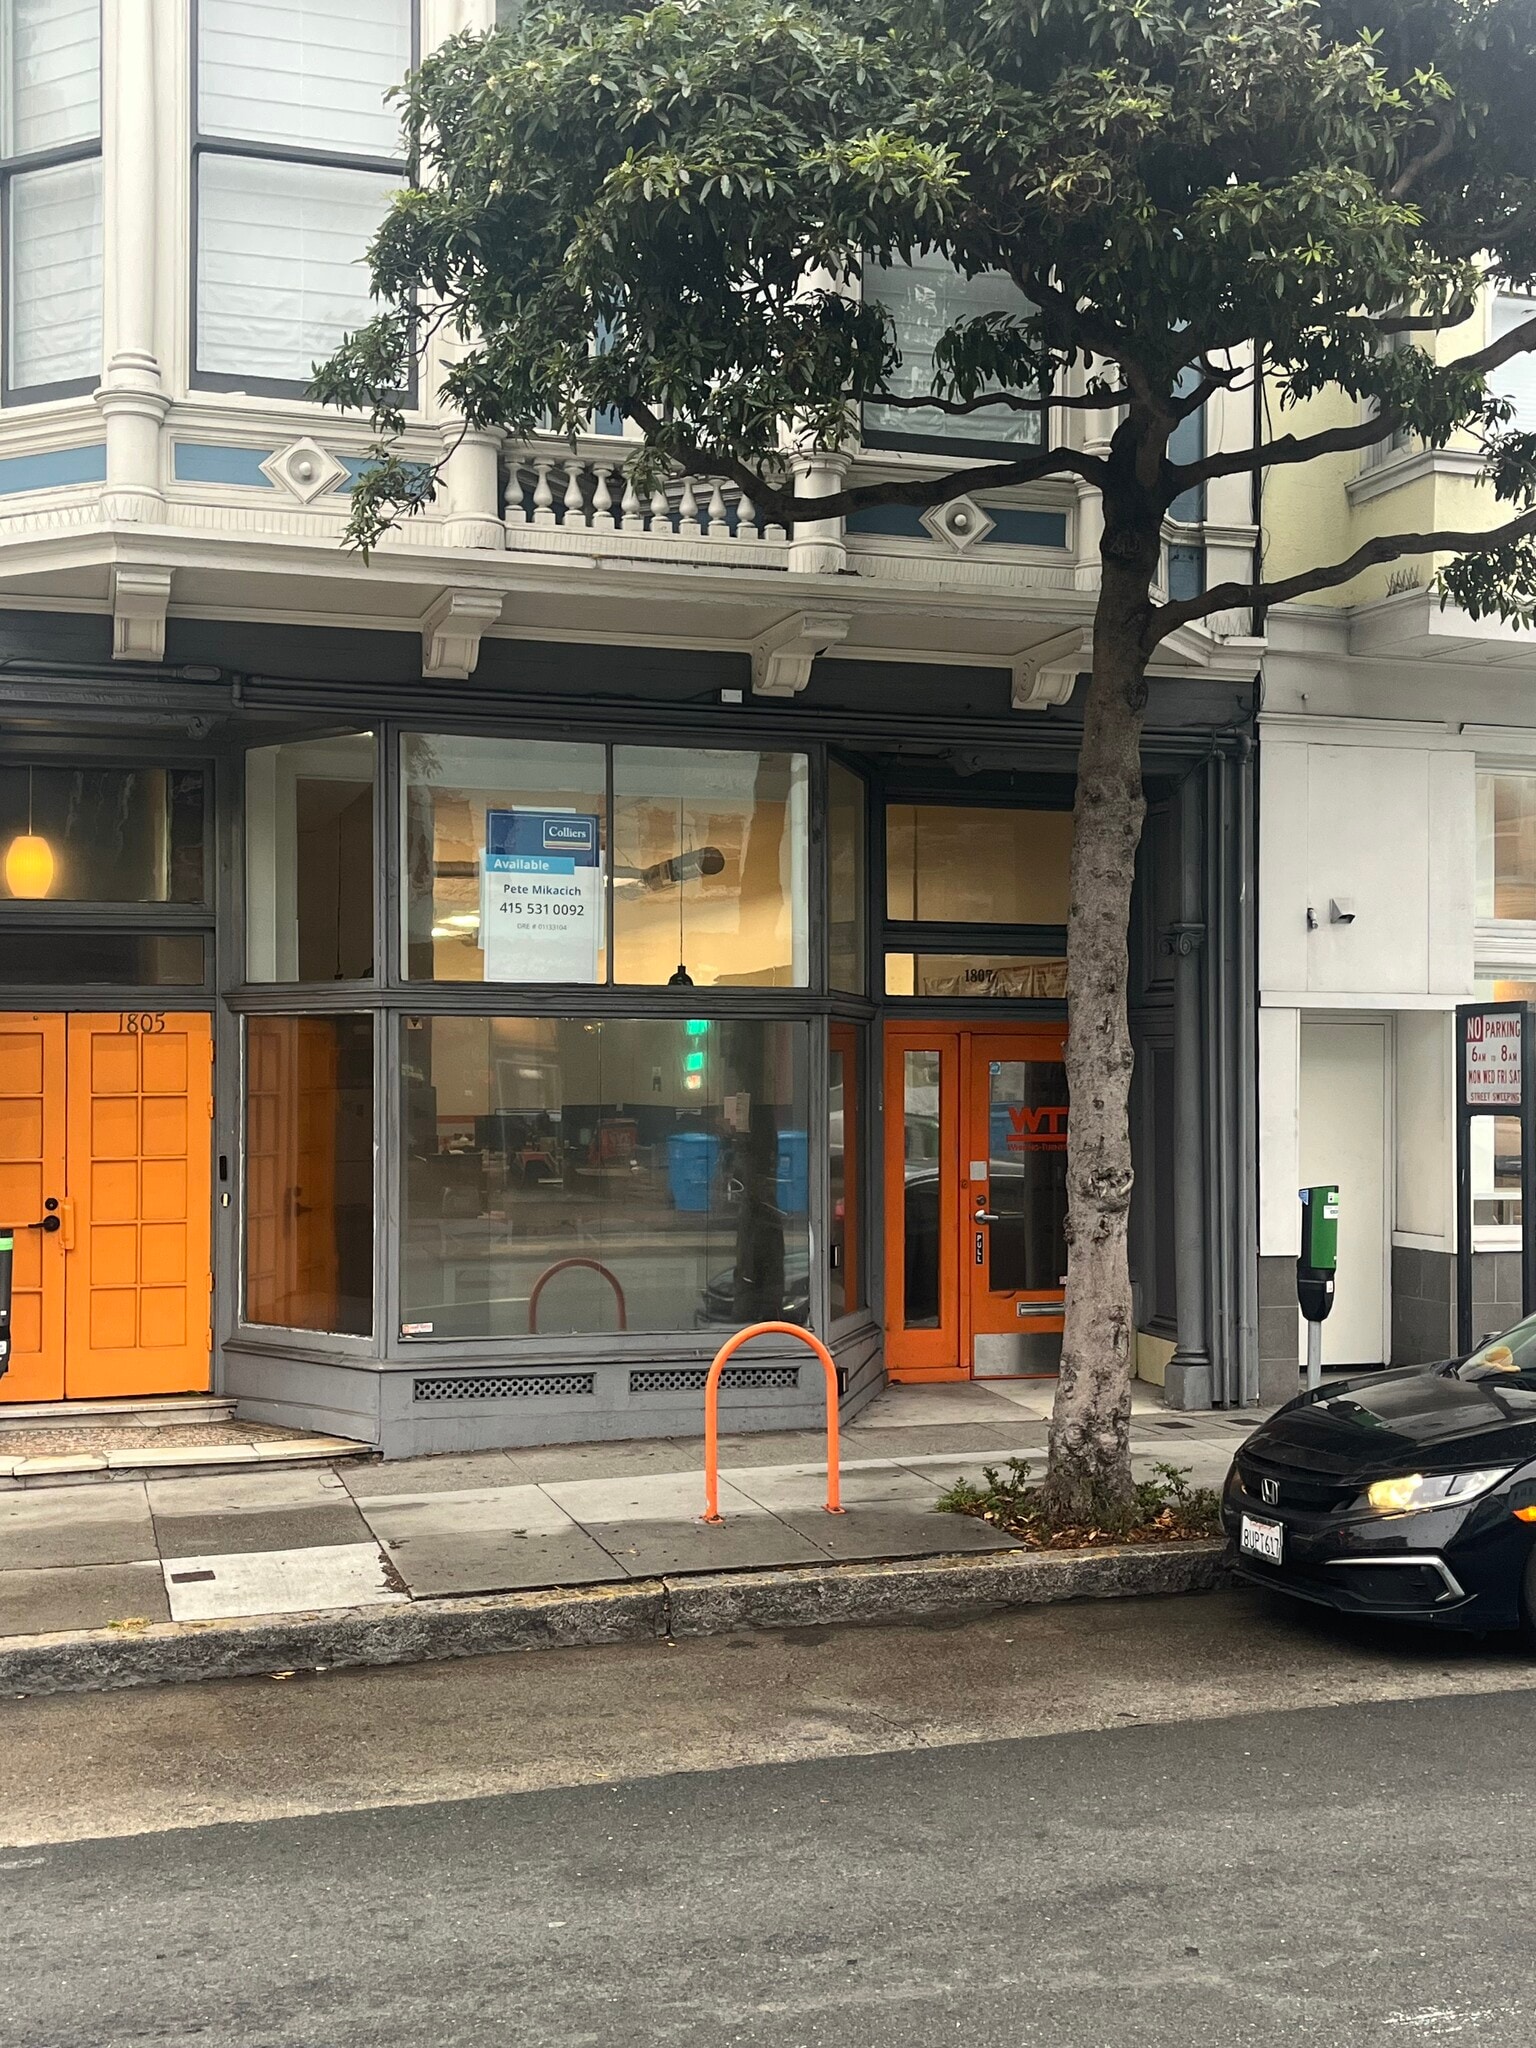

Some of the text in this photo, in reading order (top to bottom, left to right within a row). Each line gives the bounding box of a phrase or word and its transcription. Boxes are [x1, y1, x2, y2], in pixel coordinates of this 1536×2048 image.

[548, 826, 587, 839] Colliers
[493, 858, 550, 871] Available
[503, 884, 582, 896] Pete Mikacich
[499, 902, 585, 916] 415 531 0092
[965, 968, 993, 983] 1807
[119, 1012, 166, 1034] 1805
[1467, 1017, 1520, 1039] NO PARKING
[1472, 1046, 1486, 1062] 6AM
[1501, 1045, 1517, 1061] 8AM
[1468, 1069, 1520, 1084] MON WED FRI SAT
[1470, 1092, 1520, 1102] STREET SWEEPING
[1007, 1106, 1068, 1133] WT
[1244, 1528, 1279, 1557] 8UPT617
